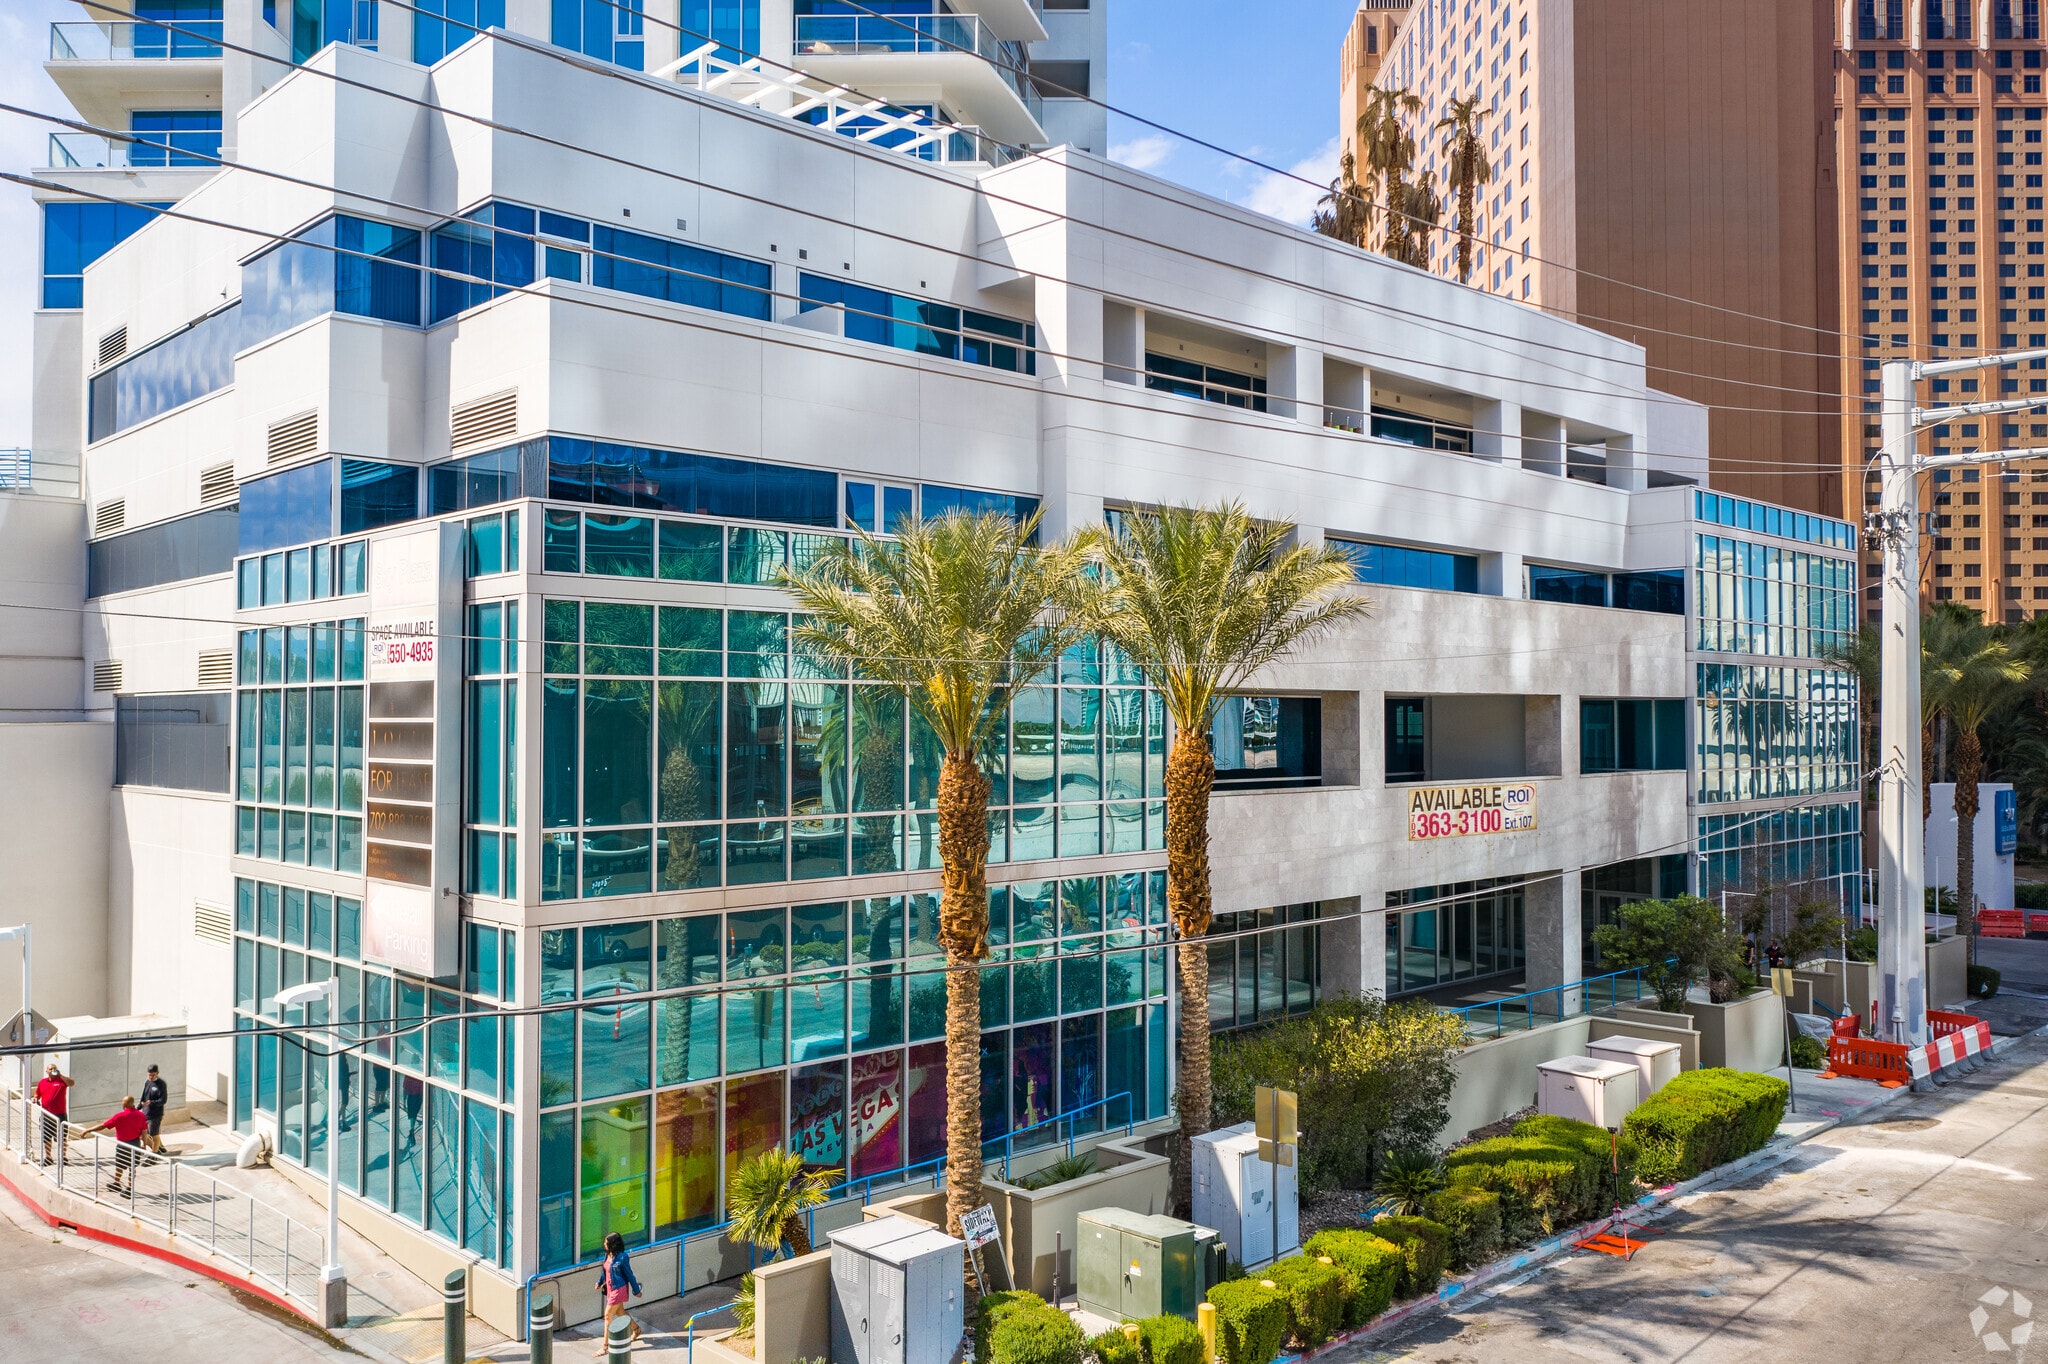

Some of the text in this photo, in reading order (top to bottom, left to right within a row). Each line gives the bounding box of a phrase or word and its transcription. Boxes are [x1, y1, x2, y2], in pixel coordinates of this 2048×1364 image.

[371, 621, 434, 641] SPACE AVAILABLE
[389, 641, 433, 663] 550-4935
[370, 769, 392, 793] FOR
[1411, 787, 1502, 812] AVAILABLE
[1507, 789, 1529, 804] ROI
[369, 811, 386, 831] 702
[1416, 808, 1502, 838] 363-3100
[384, 924, 428, 963] Parking
[790, 1123, 825, 1154] LAS
[831, 1081, 900, 1136] VEGA
[816, 1122, 874, 1157] NEVDA
